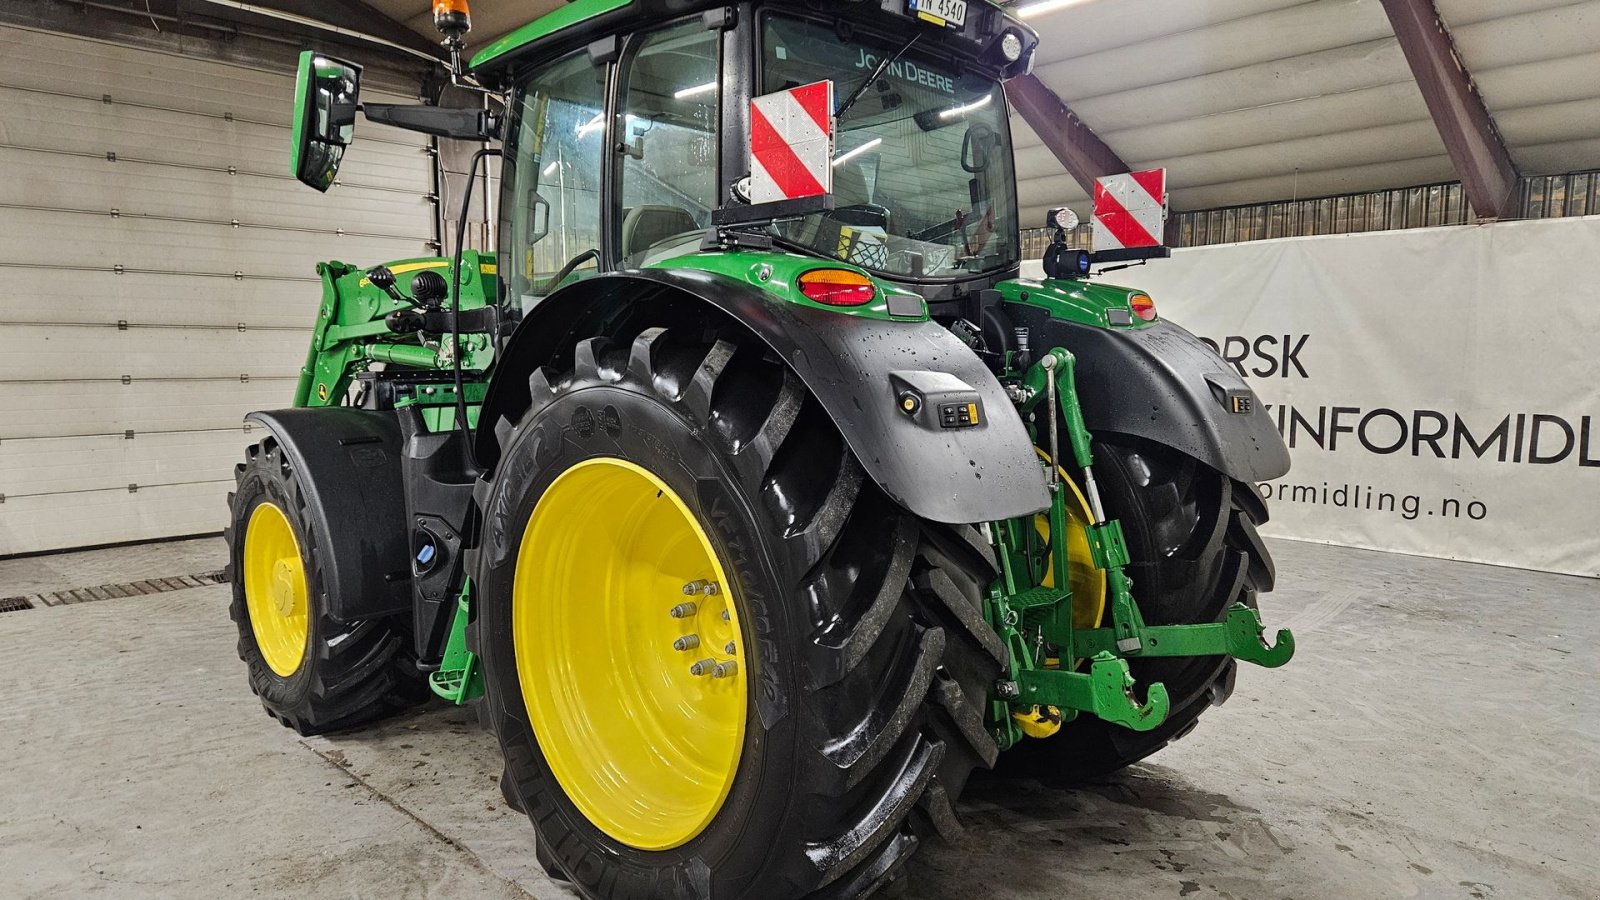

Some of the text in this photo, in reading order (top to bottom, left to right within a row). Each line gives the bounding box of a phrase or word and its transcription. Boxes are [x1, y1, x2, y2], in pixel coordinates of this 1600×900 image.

[938, 0, 964, 21] 4540
[905, 61, 955, 94] DEERE
[1265, 404, 1600, 468] INFORMIDL
[1258, 482, 1488, 521] ormidling.no
